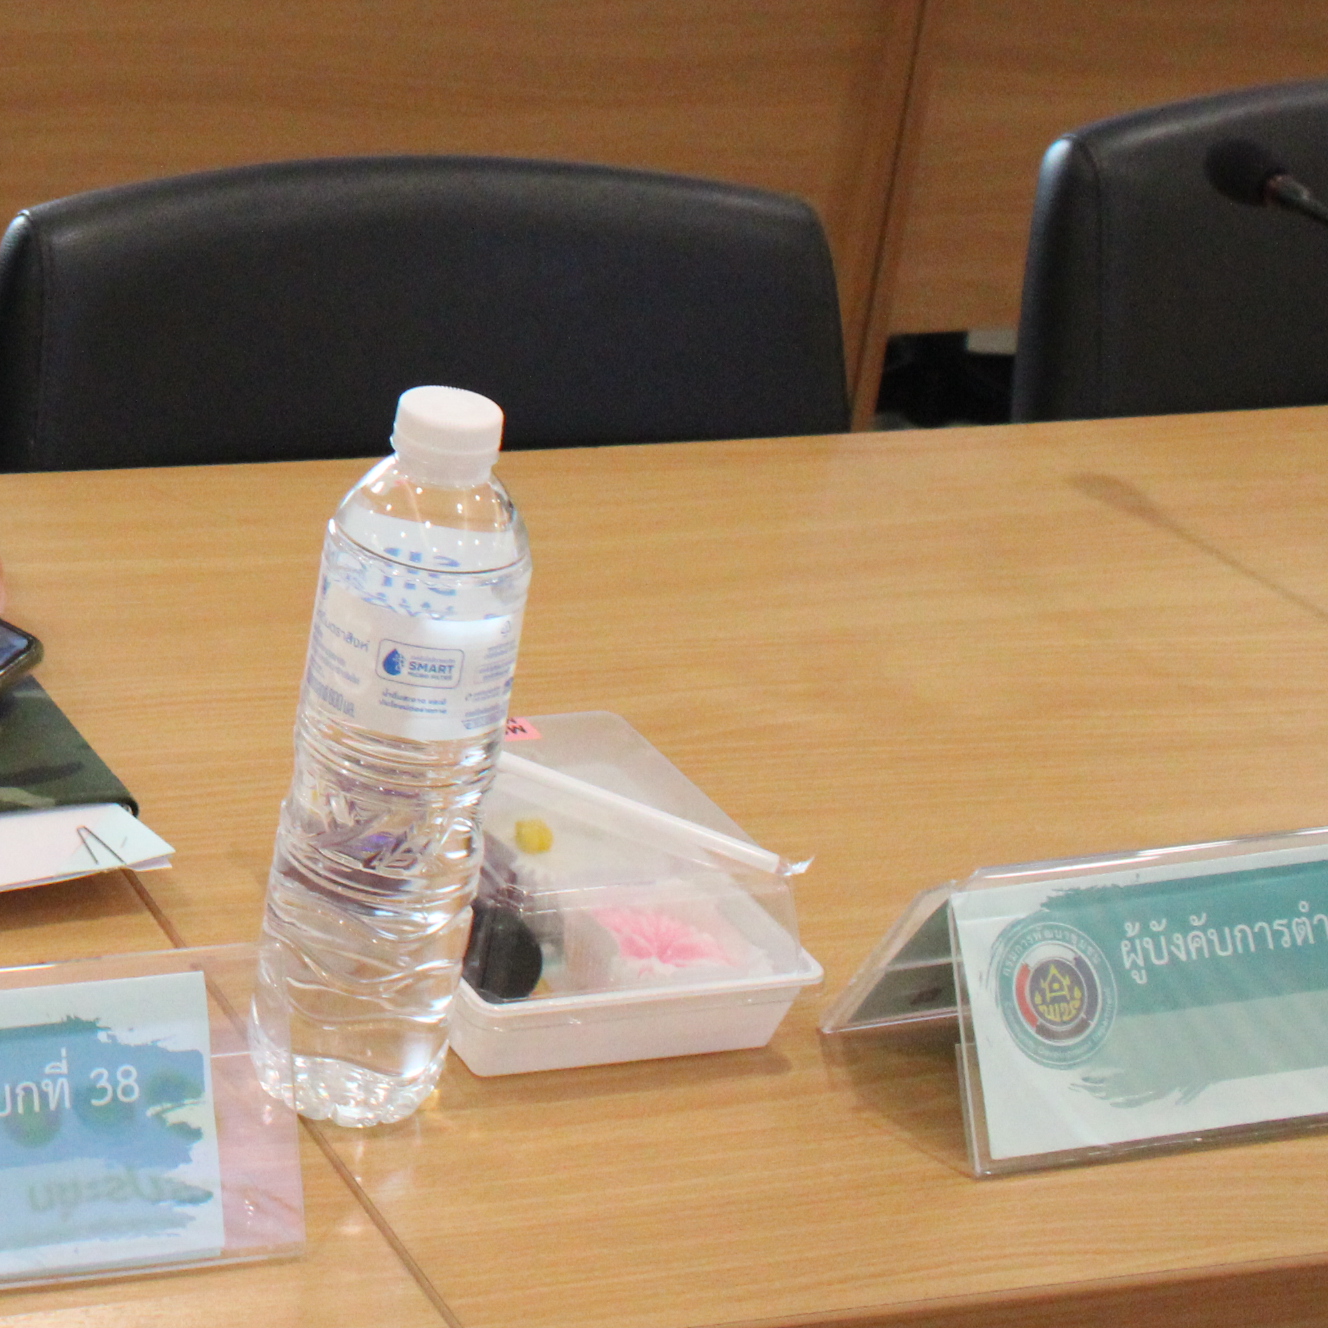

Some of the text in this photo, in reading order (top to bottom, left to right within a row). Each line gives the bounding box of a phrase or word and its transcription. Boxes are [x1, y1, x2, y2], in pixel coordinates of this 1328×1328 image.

[409, 660, 455, 675] SMART
[1120, 899, 1328, 985] ผู้บังคับการตำ
[89, 1063, 141, 1107] 38
